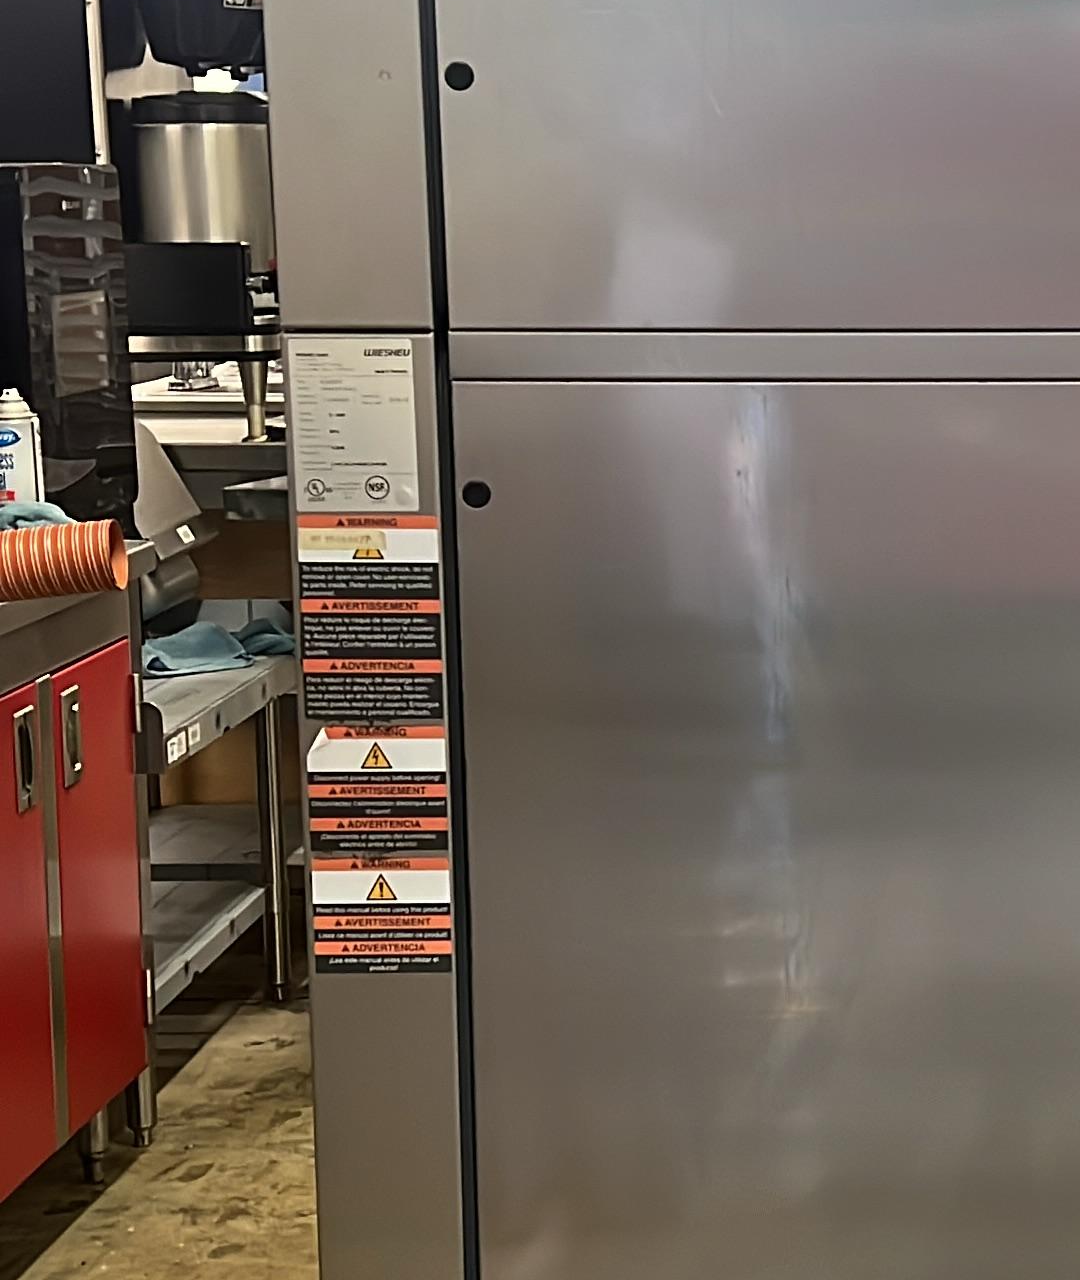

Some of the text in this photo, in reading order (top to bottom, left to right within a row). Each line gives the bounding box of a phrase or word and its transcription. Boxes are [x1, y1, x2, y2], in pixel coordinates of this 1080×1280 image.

[368, 482, 385, 492] NSF
[331, 602, 419, 611] AVERTISSEMENT
[341, 662, 415, 670] ADVERTENCIA
[355, 728, 407, 737] WARNING
[339, 786, 426, 795] AVERTISSEMENT
[347, 820, 421, 829] ADVERTENCIA
[361, 861, 411, 869] WARNING
[345, 918, 431, 927] AVERTISSEMENT
[352, 943, 426, 952] ADVERTENCIA
